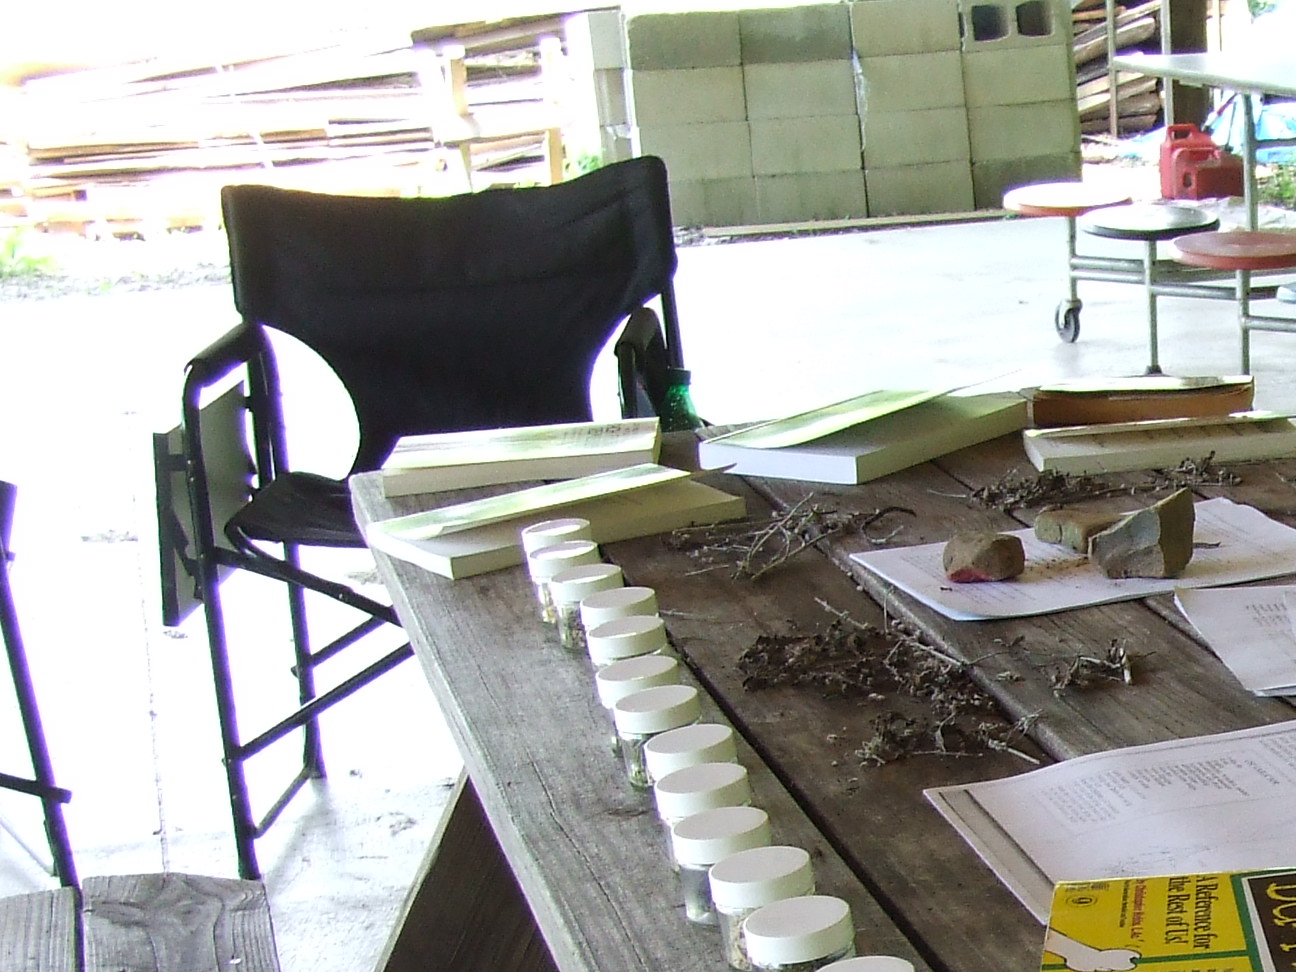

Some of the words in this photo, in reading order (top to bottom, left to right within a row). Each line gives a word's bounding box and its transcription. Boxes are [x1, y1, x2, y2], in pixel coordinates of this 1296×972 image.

[1168, 876, 1191, 892] the
[1167, 893, 1191, 915] Rest
[1194, 883, 1219, 932] Reference
[1165, 916, 1190, 927] of
[1164, 928, 1190, 944] Us!
[1193, 933, 1218, 949] for
